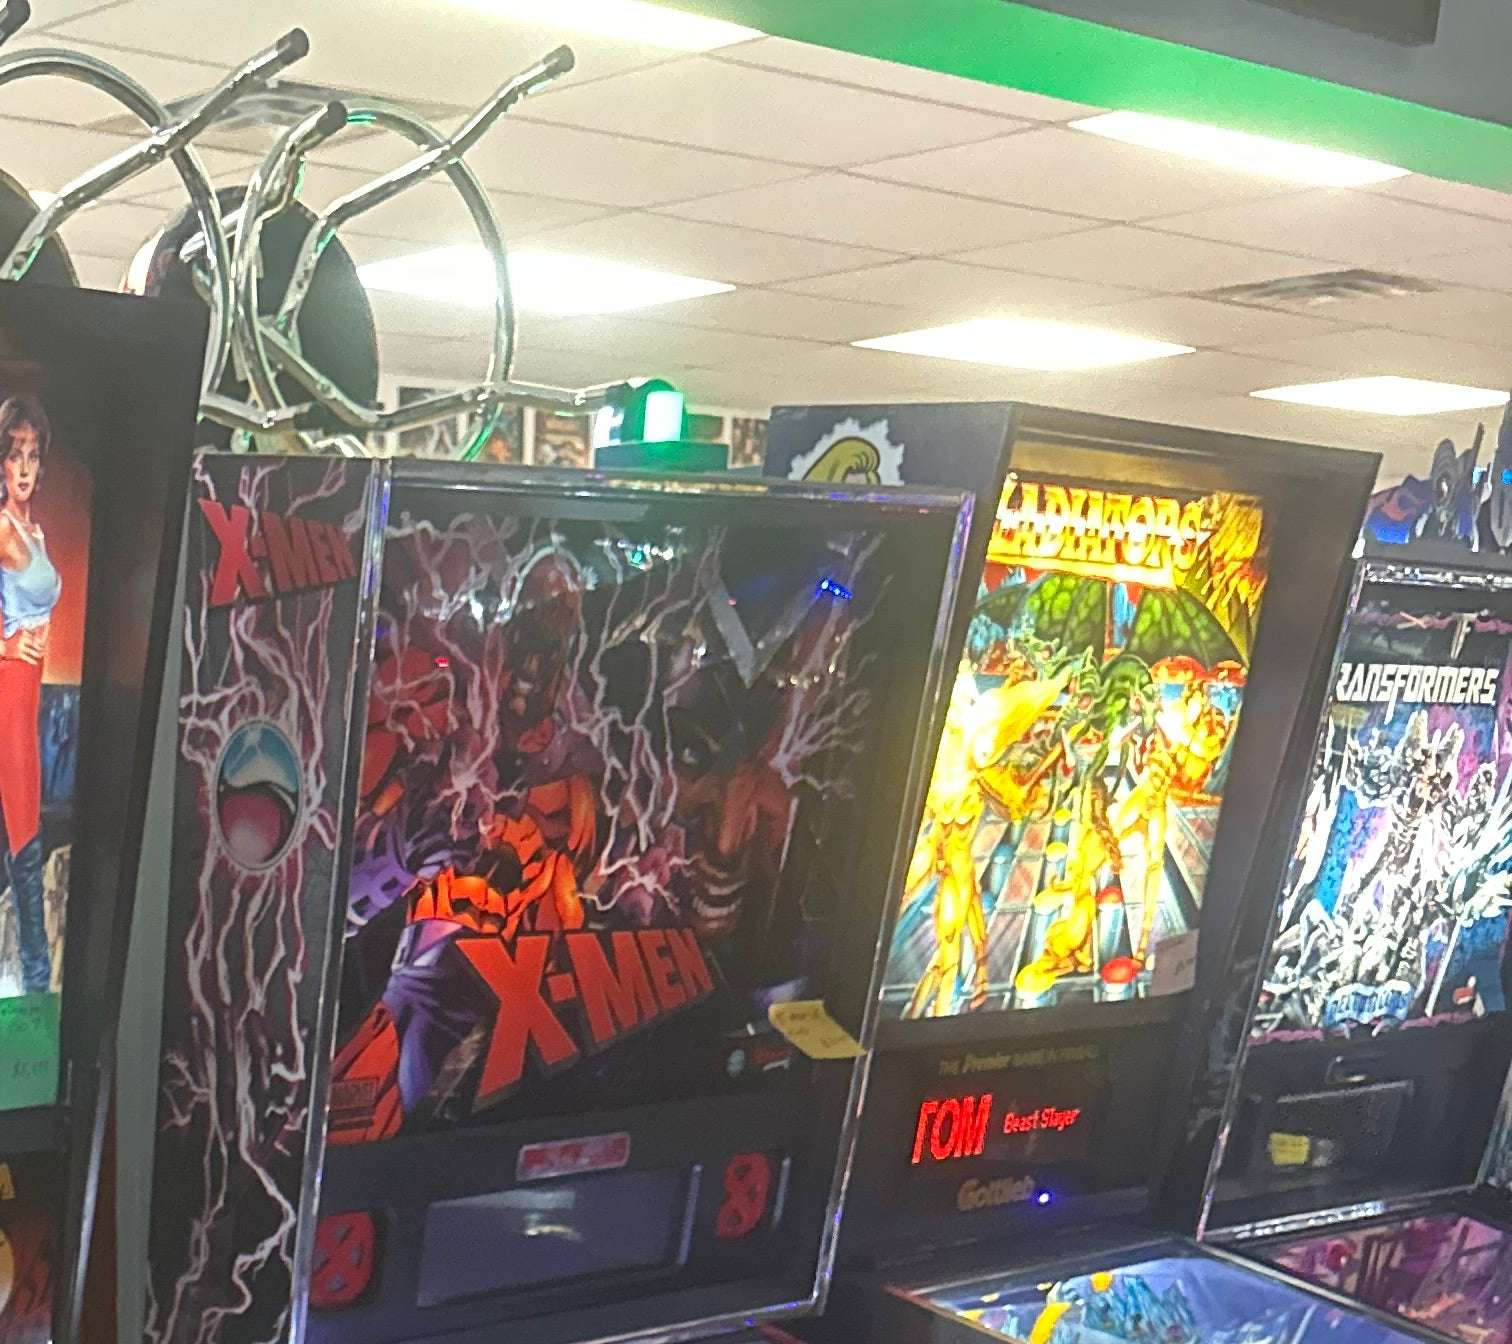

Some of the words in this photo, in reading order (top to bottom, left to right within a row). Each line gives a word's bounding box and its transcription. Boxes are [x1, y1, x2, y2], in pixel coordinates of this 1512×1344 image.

[197, 497, 358, 608] X-MEN
[988, 476, 1205, 570] LADIATORS
[1335, 661, 1500, 725] RANSFORMERS
[455, 927, 716, 1103] X-MEN
[1003, 1111, 1038, 1134] Beast
[1040, 1107, 1082, 1132] Slayer
